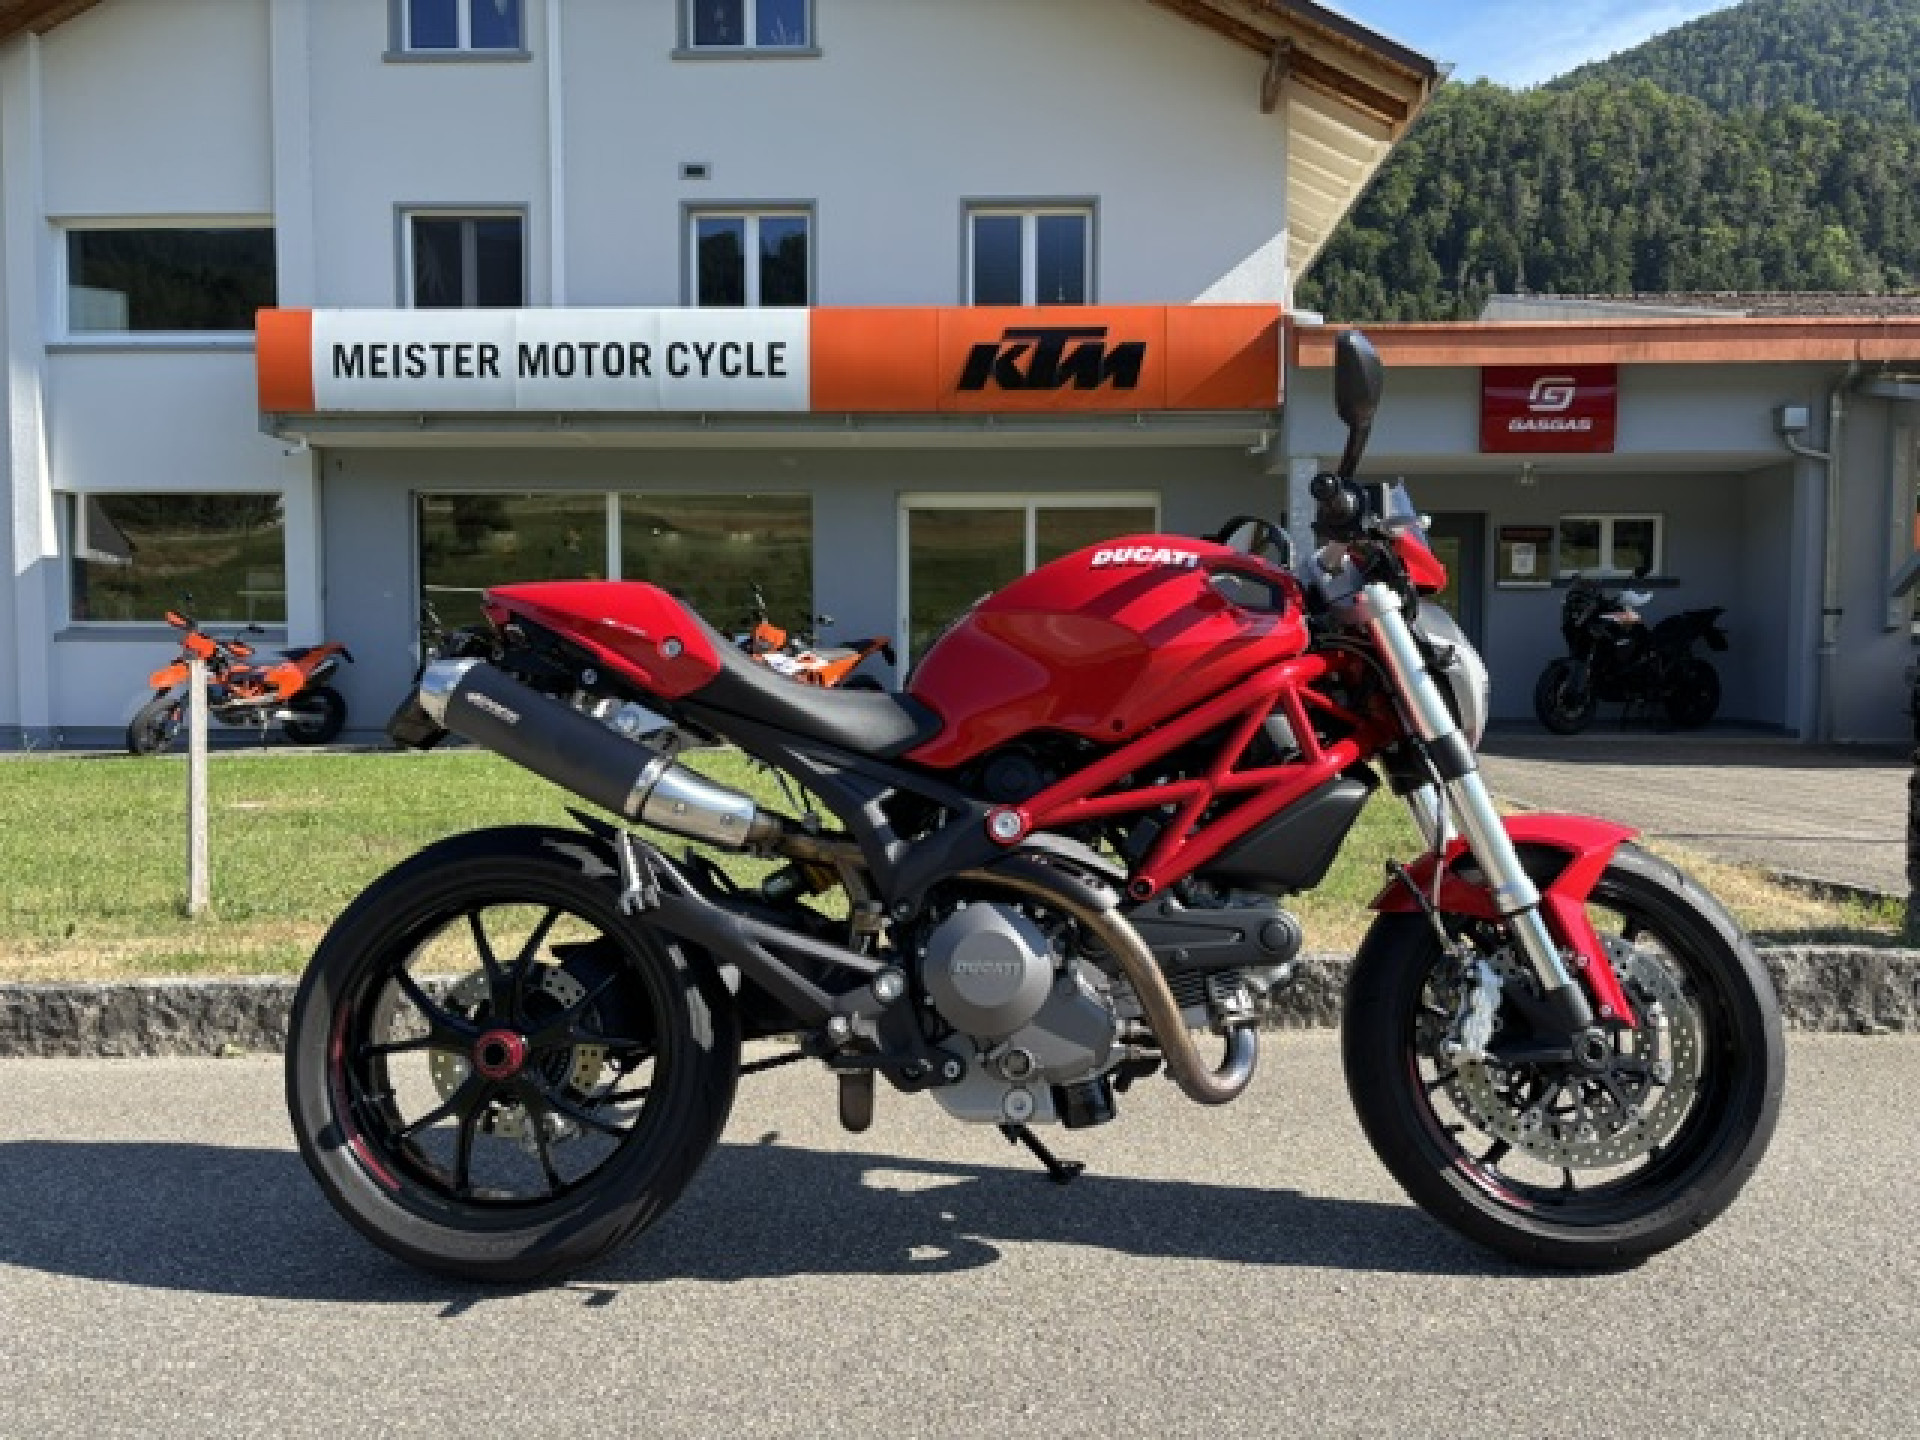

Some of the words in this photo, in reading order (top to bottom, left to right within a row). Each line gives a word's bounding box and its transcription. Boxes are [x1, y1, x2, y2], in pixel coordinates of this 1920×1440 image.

[332, 342, 500, 379] MEISTER
[517, 342, 652, 379] MOTOR
[665, 341, 788, 378] CYCLE
[957, 326, 1147, 390] KTM
[1508, 417, 1592, 432] GASGAS
[1091, 546, 1199, 568] DUCATI
